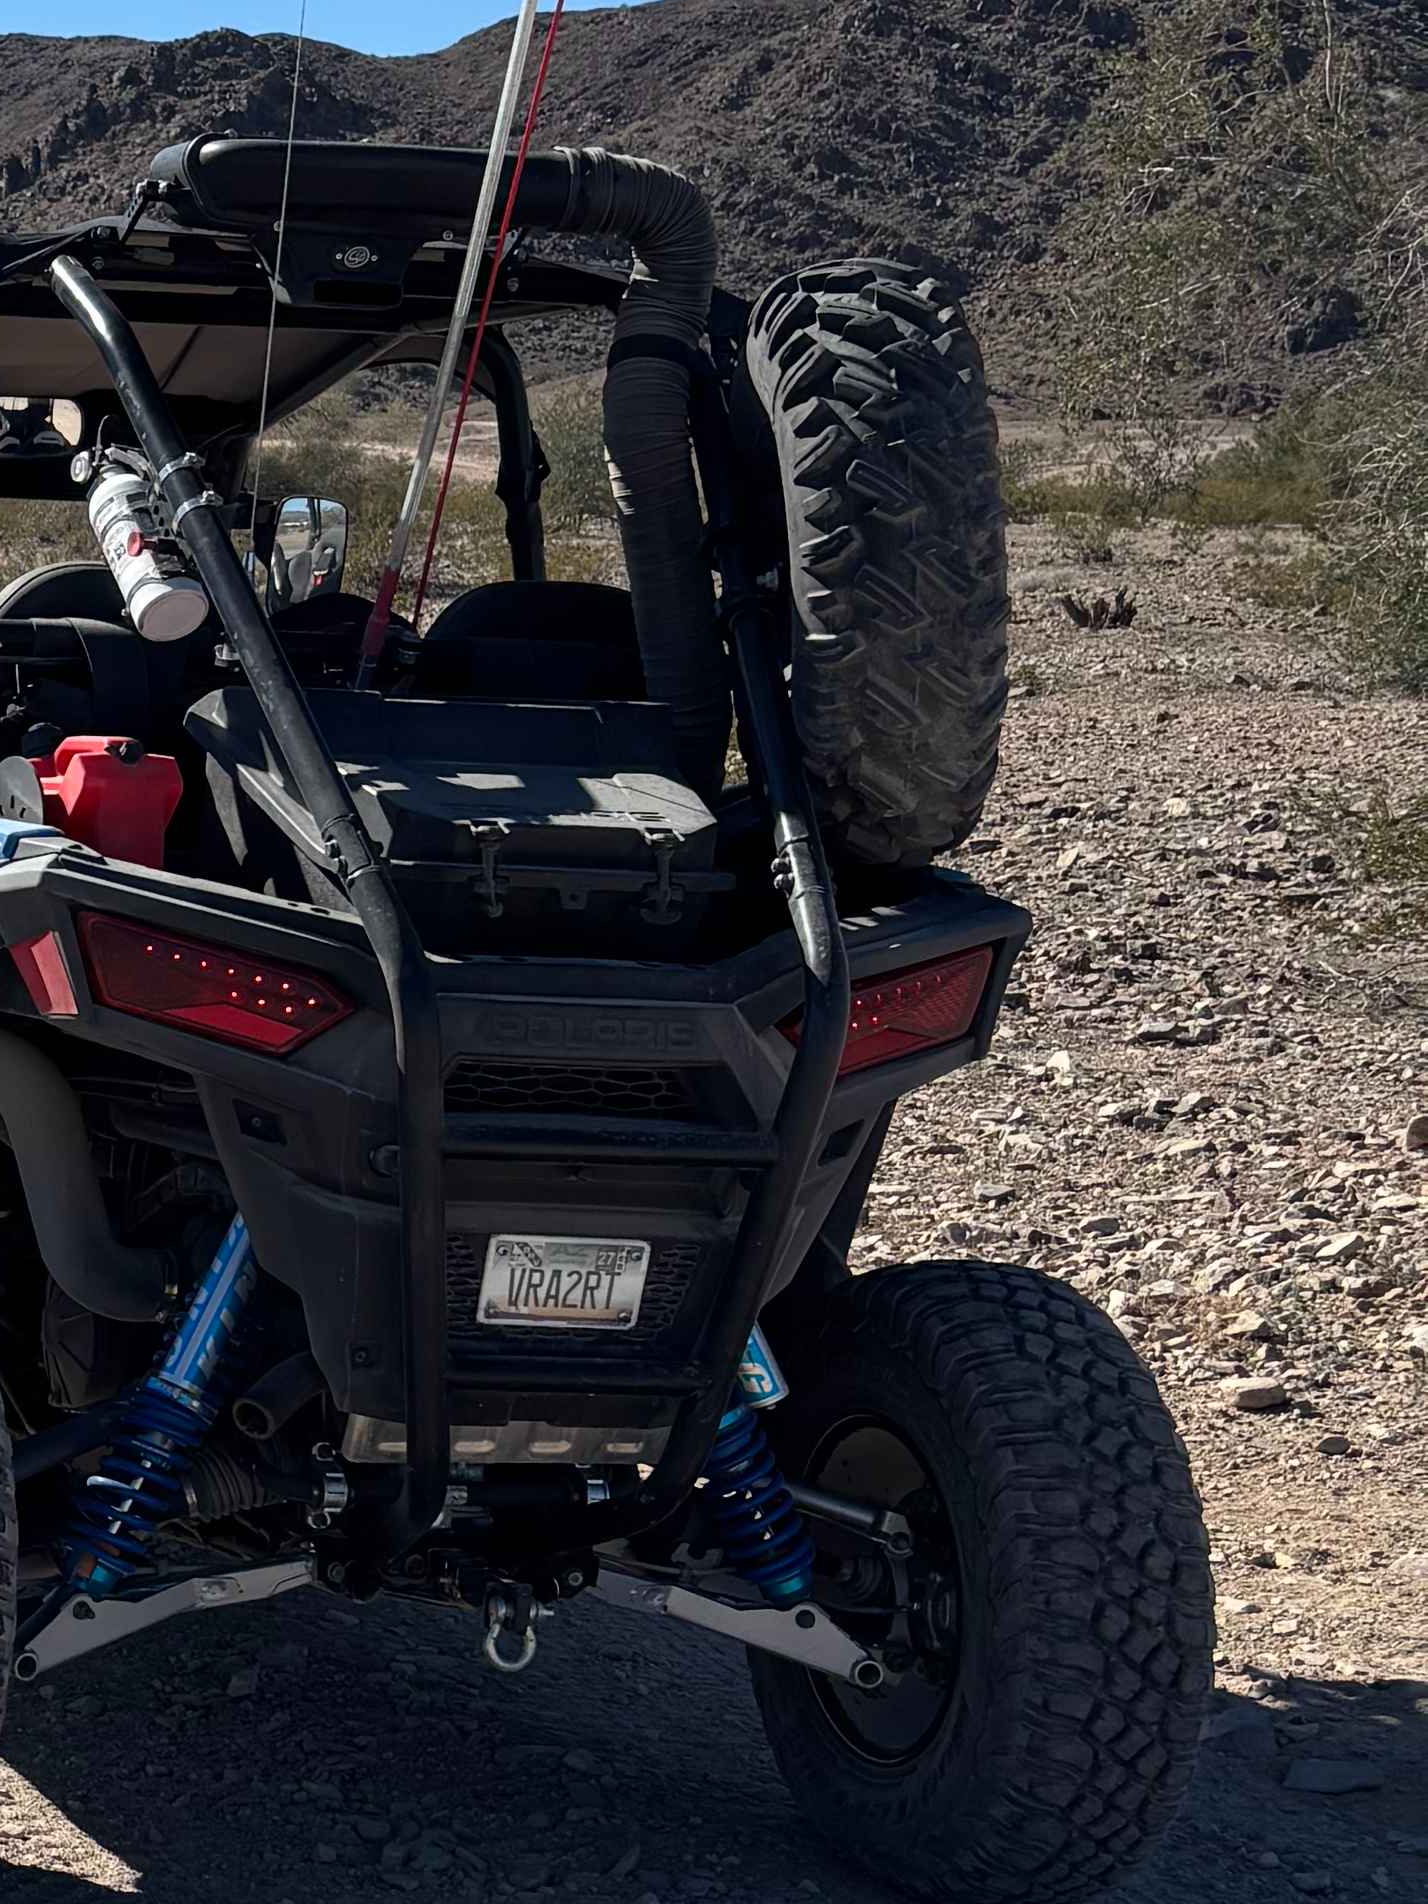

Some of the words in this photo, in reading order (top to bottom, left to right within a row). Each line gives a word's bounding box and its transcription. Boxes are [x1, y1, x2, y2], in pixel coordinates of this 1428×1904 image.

[493, 1014, 699, 1050] POLARIS
[597, 1251, 617, 1266] 27
[507, 1268, 622, 1310] VRA2RT
